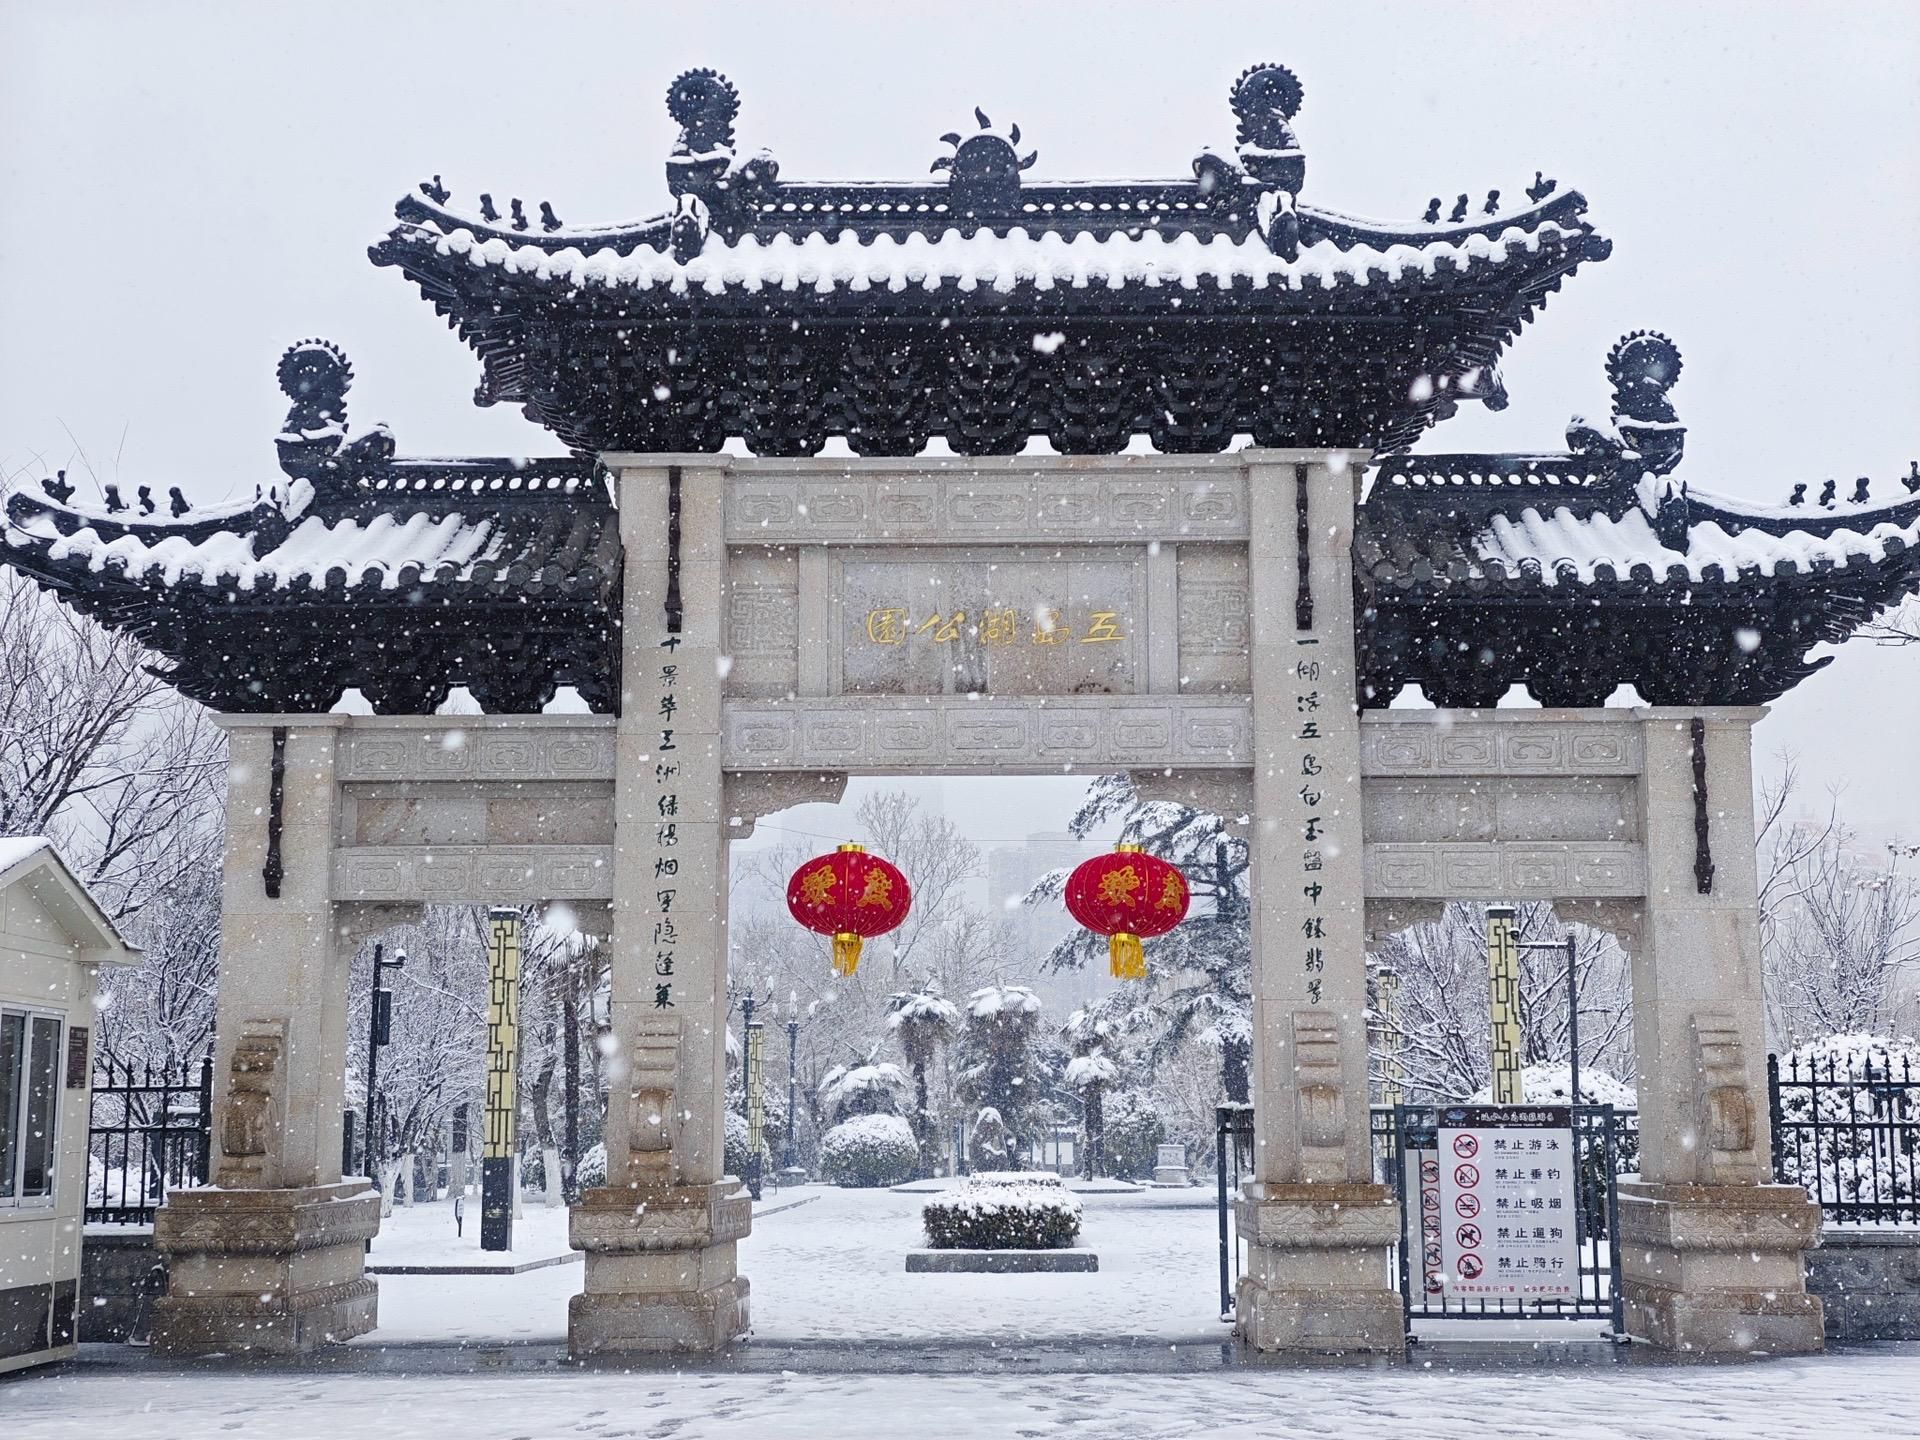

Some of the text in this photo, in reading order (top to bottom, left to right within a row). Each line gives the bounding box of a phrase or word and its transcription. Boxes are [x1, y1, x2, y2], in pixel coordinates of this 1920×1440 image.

[1494, 1139, 1559, 1151] 禁止游泳
[1495, 1168, 1560, 1180] 禁止垂钓
[1496, 1198, 1562, 1209] 禁止吸烟
[1497, 1227, 1563, 1239] 禁止遛狗
[1498, 1257, 1564, 1269] 禁止骑行
